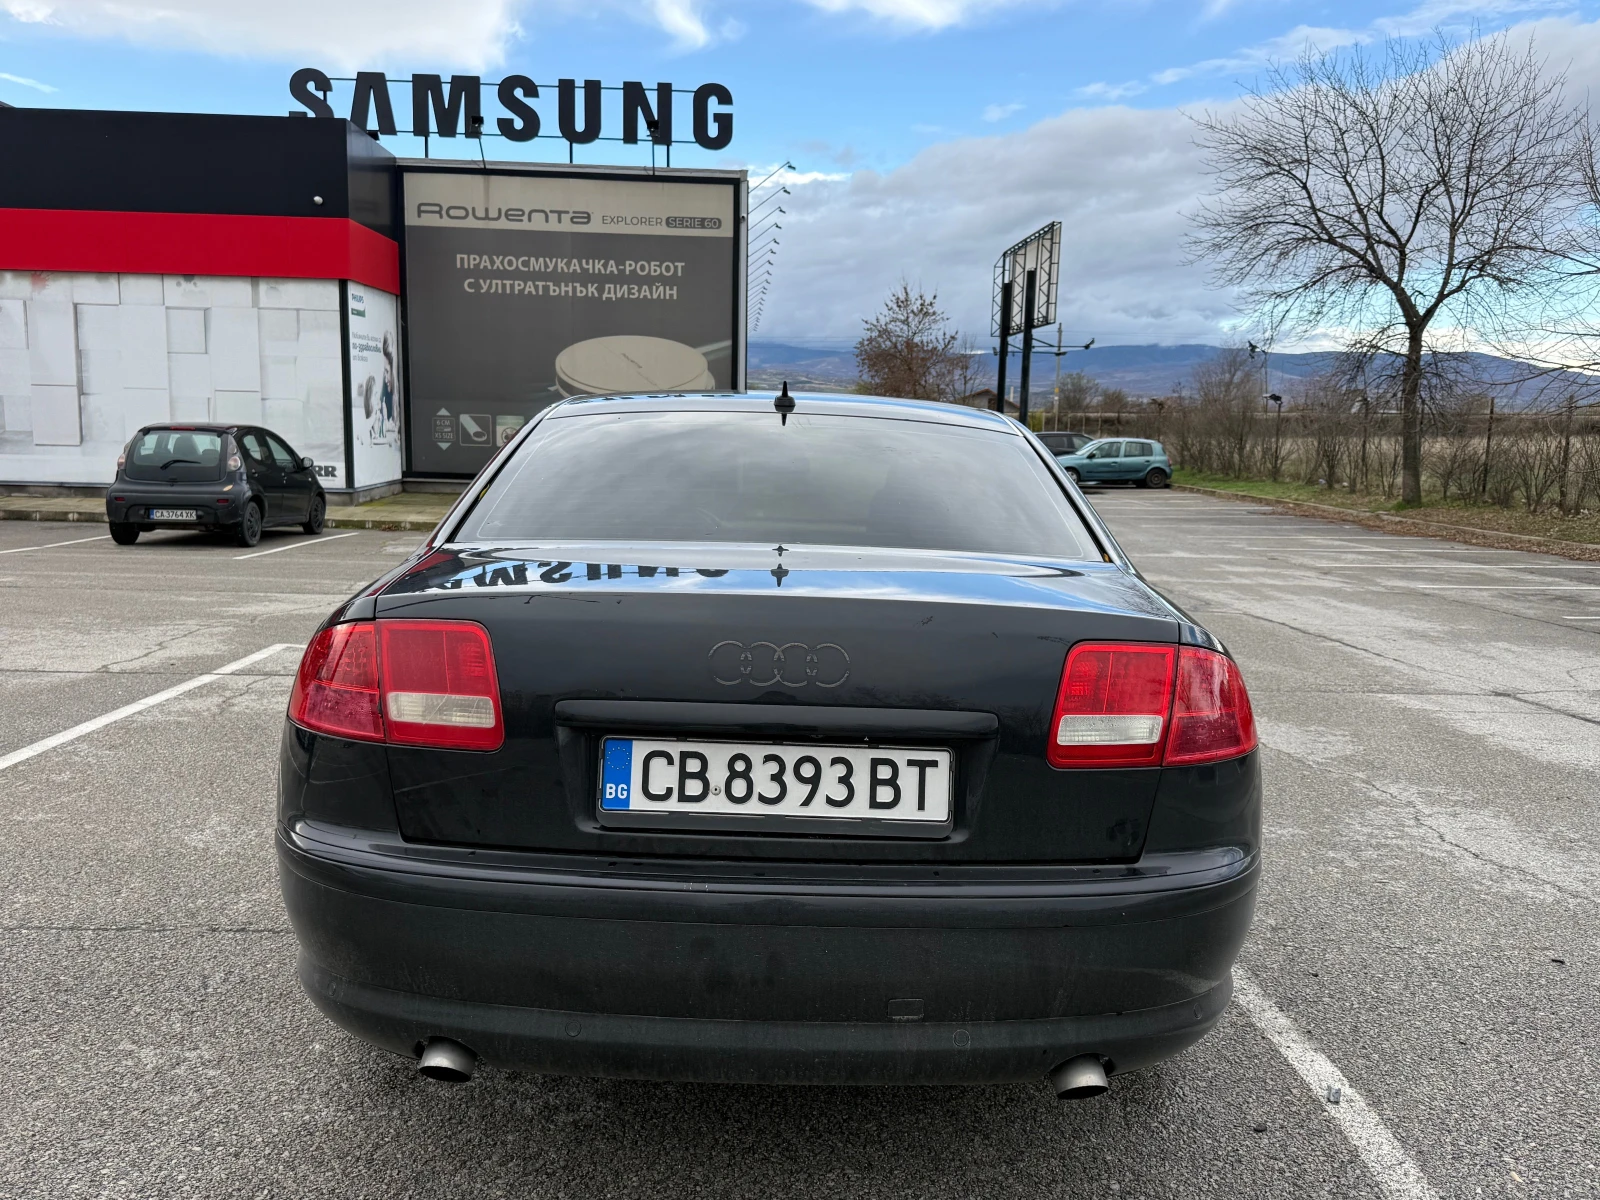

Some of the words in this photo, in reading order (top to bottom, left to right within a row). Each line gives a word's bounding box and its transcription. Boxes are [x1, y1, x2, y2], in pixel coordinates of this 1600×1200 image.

[289, 67, 734, 150] SAMSUNG
[601, 215, 663, 227] EXPLORER
[668, 217, 702, 229] SERIE
[704, 218, 720, 229] 60
[456, 253, 685, 277] ПРАХОСМУКАЧКА-РОБОТ
[463, 278, 475, 293] С
[479, 279, 599, 298] УЛТРАТЪНЪК
[602, 282, 678, 301] ДИЗАЙН
[604, 783, 629, 800] BG
[640, 749, 710, 803] CB
[723, 752, 856, 808] 8393
[868, 756, 939, 812] BT
